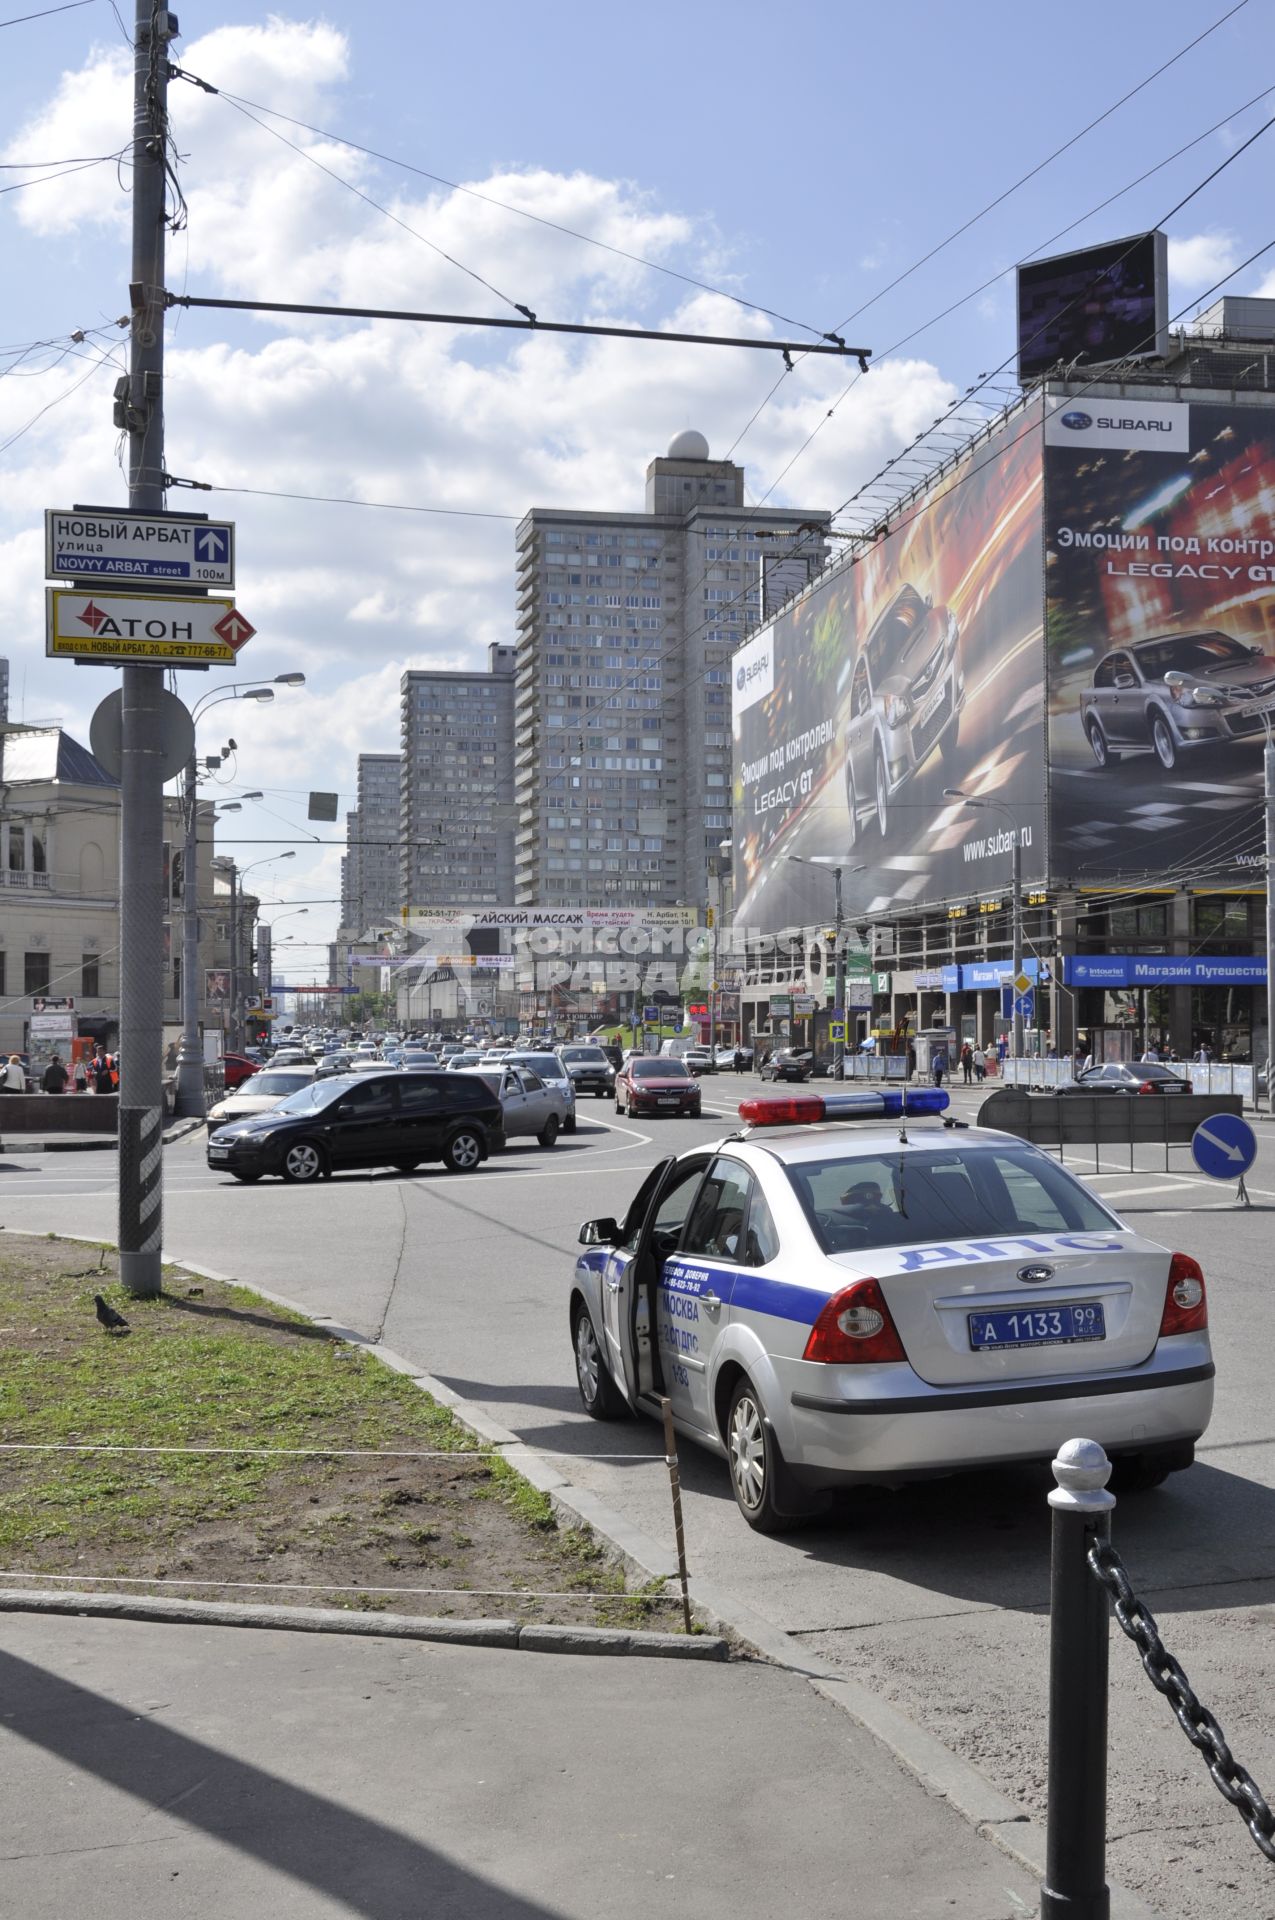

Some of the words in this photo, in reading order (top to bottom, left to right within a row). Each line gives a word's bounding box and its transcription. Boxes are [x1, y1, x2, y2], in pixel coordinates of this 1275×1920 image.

[1097, 418, 1172, 432] SUBARU
[58, 520, 127, 540] НОВЫЙ
[133, 526, 191, 543] АРБАТ
[58, 542, 103, 553] улица
[1057, 527, 1149, 552] Эмоции
[1157, 536, 1200, 555] под
[1208, 538, 1275, 559] контр
[58, 557, 103, 570] NOVYY
[106, 561, 148, 573] ARBAT
[153, 566, 181, 575] street
[1107, 561, 1242, 580] LEGACY
[98, 618, 192, 640] АТОН
[91, 639, 121, 652] НОВЫЙ
[188, 646, 227, 657] 777-66-77
[746, 652, 769, 682] SUBARU
[741, 755, 768, 787] Эмоции
[769, 746, 785, 772] под
[786, 718, 835, 763] контролем.
[754, 778, 799, 815] LEGACY
[799, 768, 813, 794] GT
[963, 826, 1032, 862] www.subar.ru
[472, 911, 528, 924] ТАЙСКИЙ
[533, 913, 583, 924] МАССАЖ
[1135, 964, 1191, 976] Магазин
[899, 1233, 1124, 1271] ДПС
[1027, 1269, 1047, 1279] Ford
[663, 1292, 699, 1322] МОСКВА
[984, 1323, 997, 1341] А
[1007, 1312, 1062, 1339] 1133
[1074, 1307, 1095, 1326] 99
[1078, 1326, 1095, 1334] RUS
